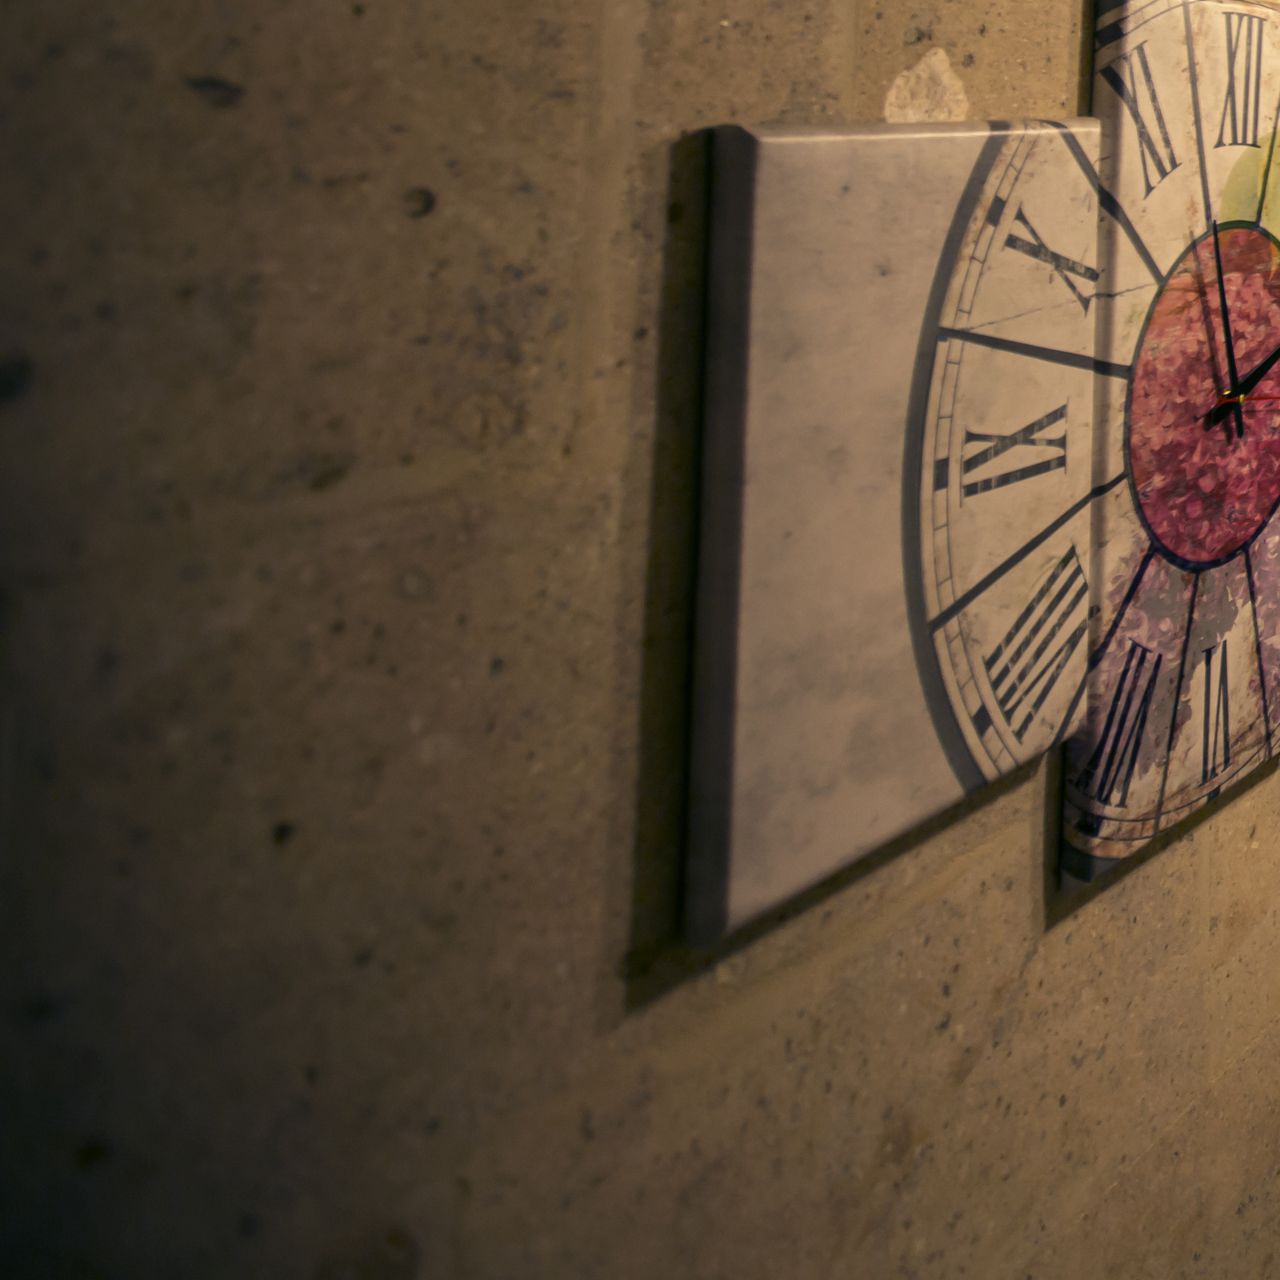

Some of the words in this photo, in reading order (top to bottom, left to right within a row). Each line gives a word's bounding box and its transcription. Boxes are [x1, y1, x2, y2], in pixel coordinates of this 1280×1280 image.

[1099, 39, 1183, 201] XI
[1214, 11, 1269, 150] XII
[1002, 200, 1102, 318] X
[960, 395, 1070, 509] IX
[982, 538, 1090, 744] VIII
[1199, 640, 1231, 788] VI
[1088, 638, 1162, 809] VII
